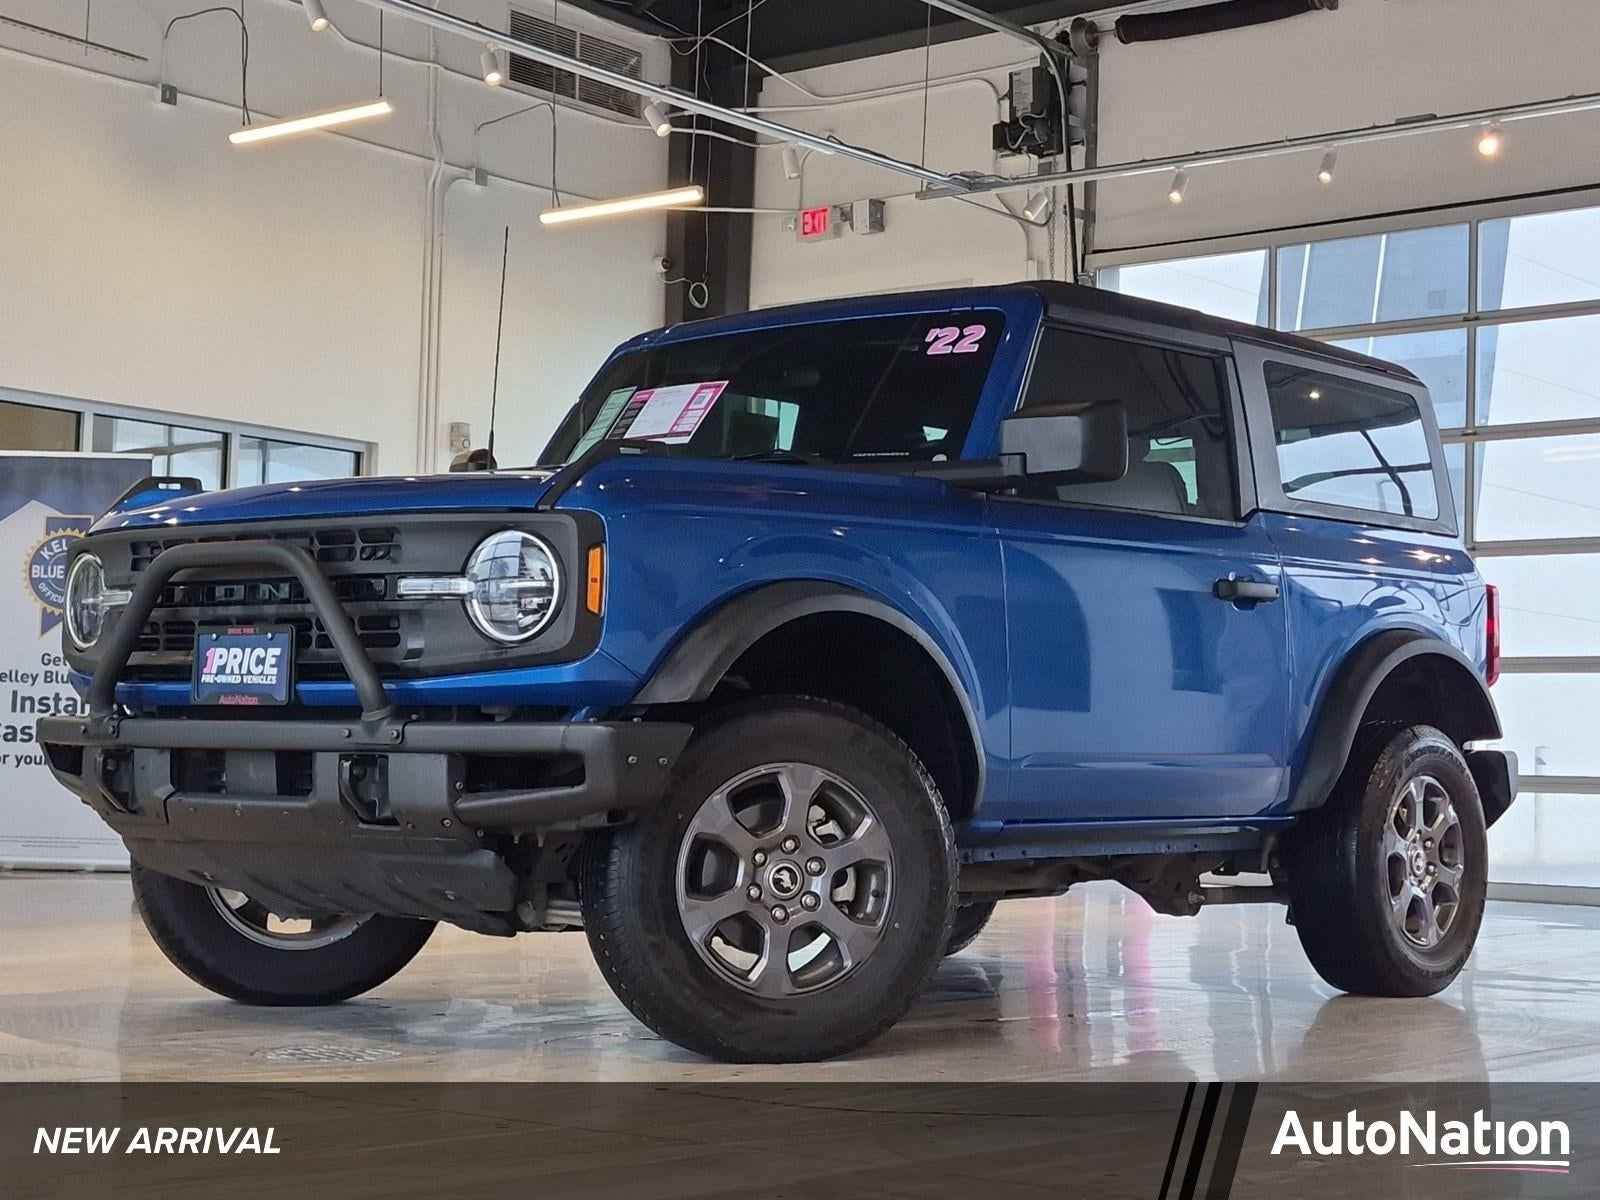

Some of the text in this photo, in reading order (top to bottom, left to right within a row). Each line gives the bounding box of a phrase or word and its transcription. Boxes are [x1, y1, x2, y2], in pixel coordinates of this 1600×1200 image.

[801, 208, 829, 236] EXIT
[925, 324, 987, 355] '22
[40, 539, 68, 560] KEL
[31, 564, 65, 579] BLUE
[0, 670, 70, 687] elley Blu
[201, 674, 277, 685] PRE-OWNED VEHICLES
[10, 689, 90, 715] Insta
